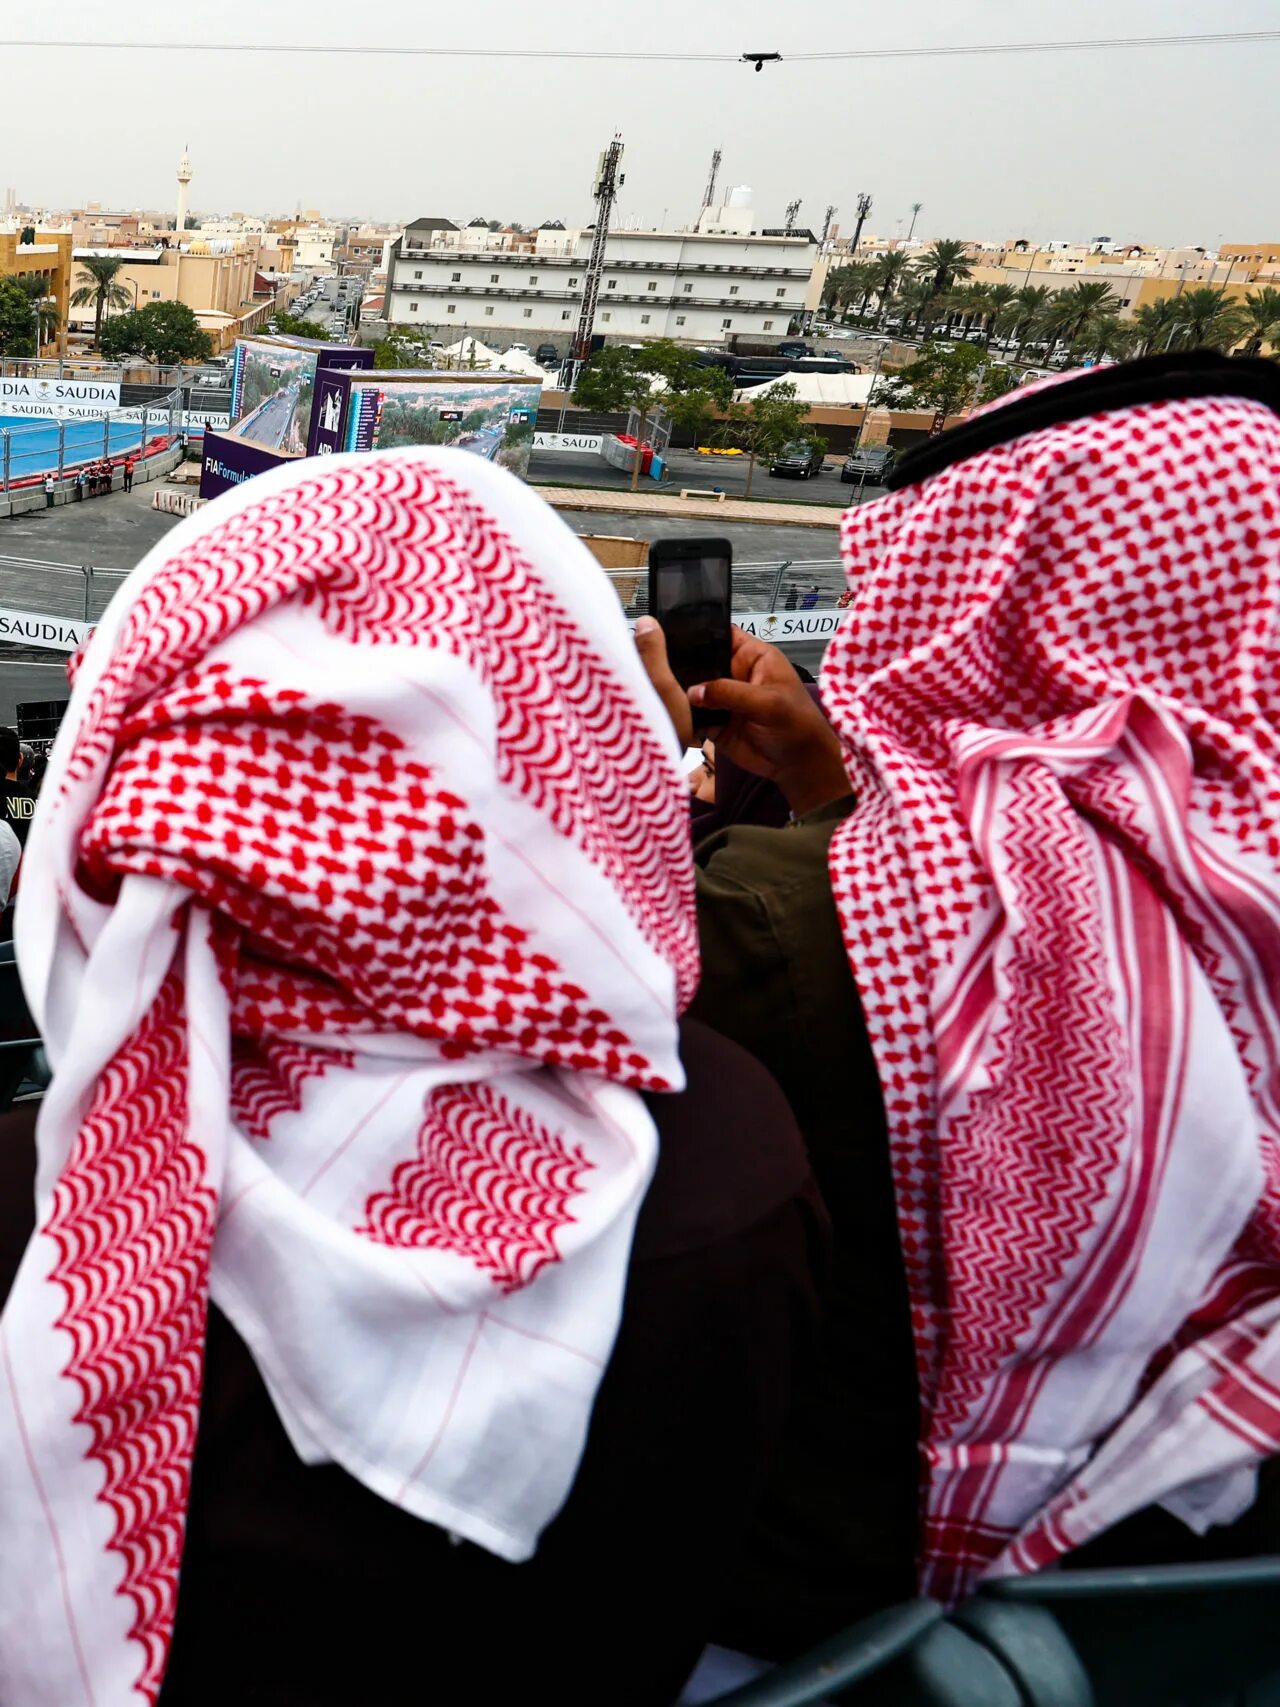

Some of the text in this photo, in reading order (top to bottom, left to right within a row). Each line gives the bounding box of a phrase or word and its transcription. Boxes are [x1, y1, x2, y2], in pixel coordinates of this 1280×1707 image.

[56, 385, 116, 400] SAUDIA
[12, 404, 53, 415] SAUDIA
[68, 408, 108, 418] SAUDI
[185, 414, 228, 424] SAUDIA
[562, 438, 598, 448] SAUD
[782, 618, 841, 634] SAUDI
